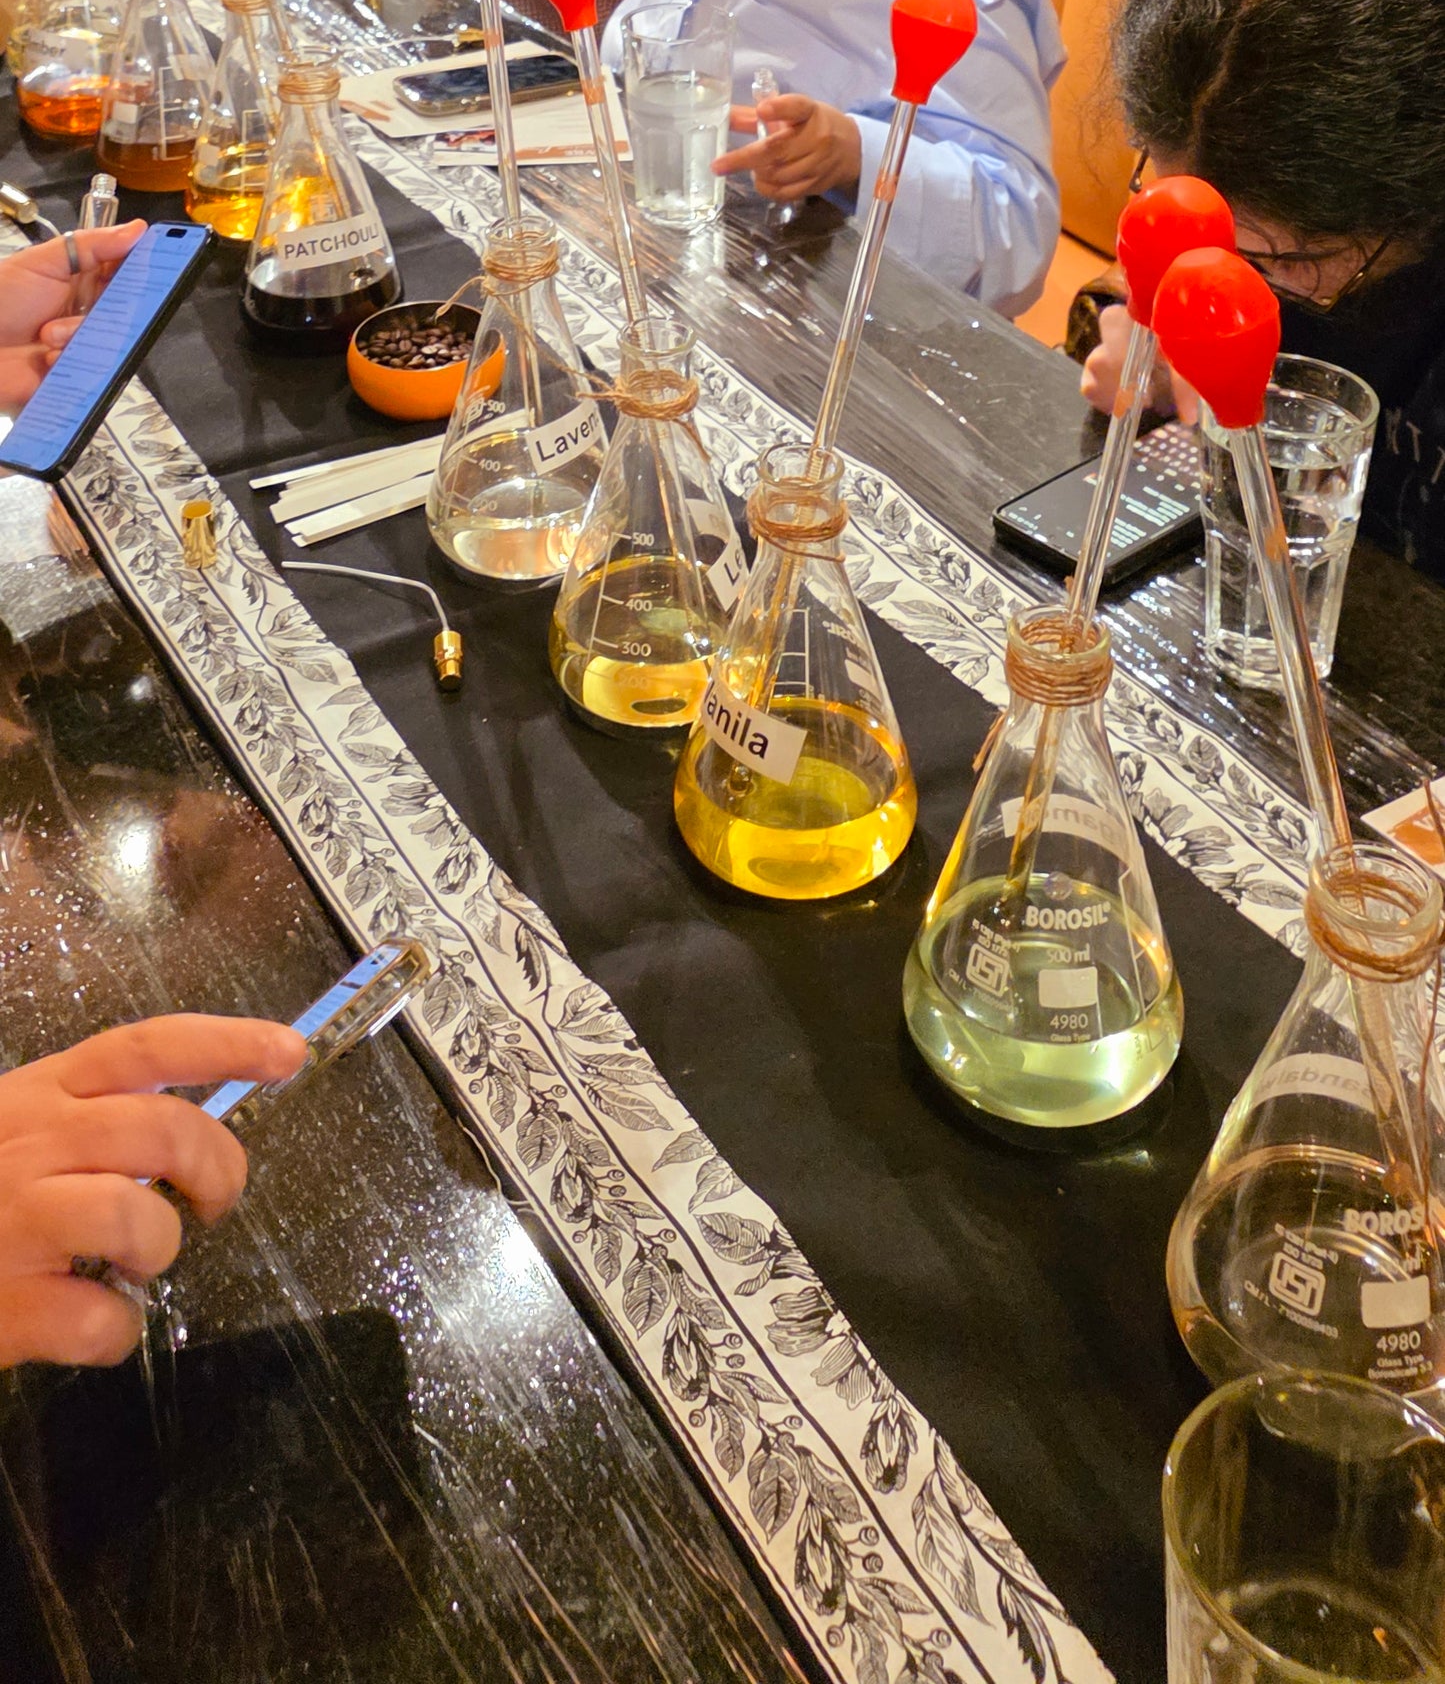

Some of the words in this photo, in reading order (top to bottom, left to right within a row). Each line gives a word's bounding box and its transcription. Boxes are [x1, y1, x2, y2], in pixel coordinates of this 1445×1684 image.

[478, 458, 501, 473] 400
[631, 532, 655, 547] 500
[625, 598, 652, 612] 400
[621, 641, 651, 657] 300
[1074, 943, 1091, 963] ml
[1050, 1013, 1089, 1030] 4980
[1376, 1330, 1421, 1352] 4980
